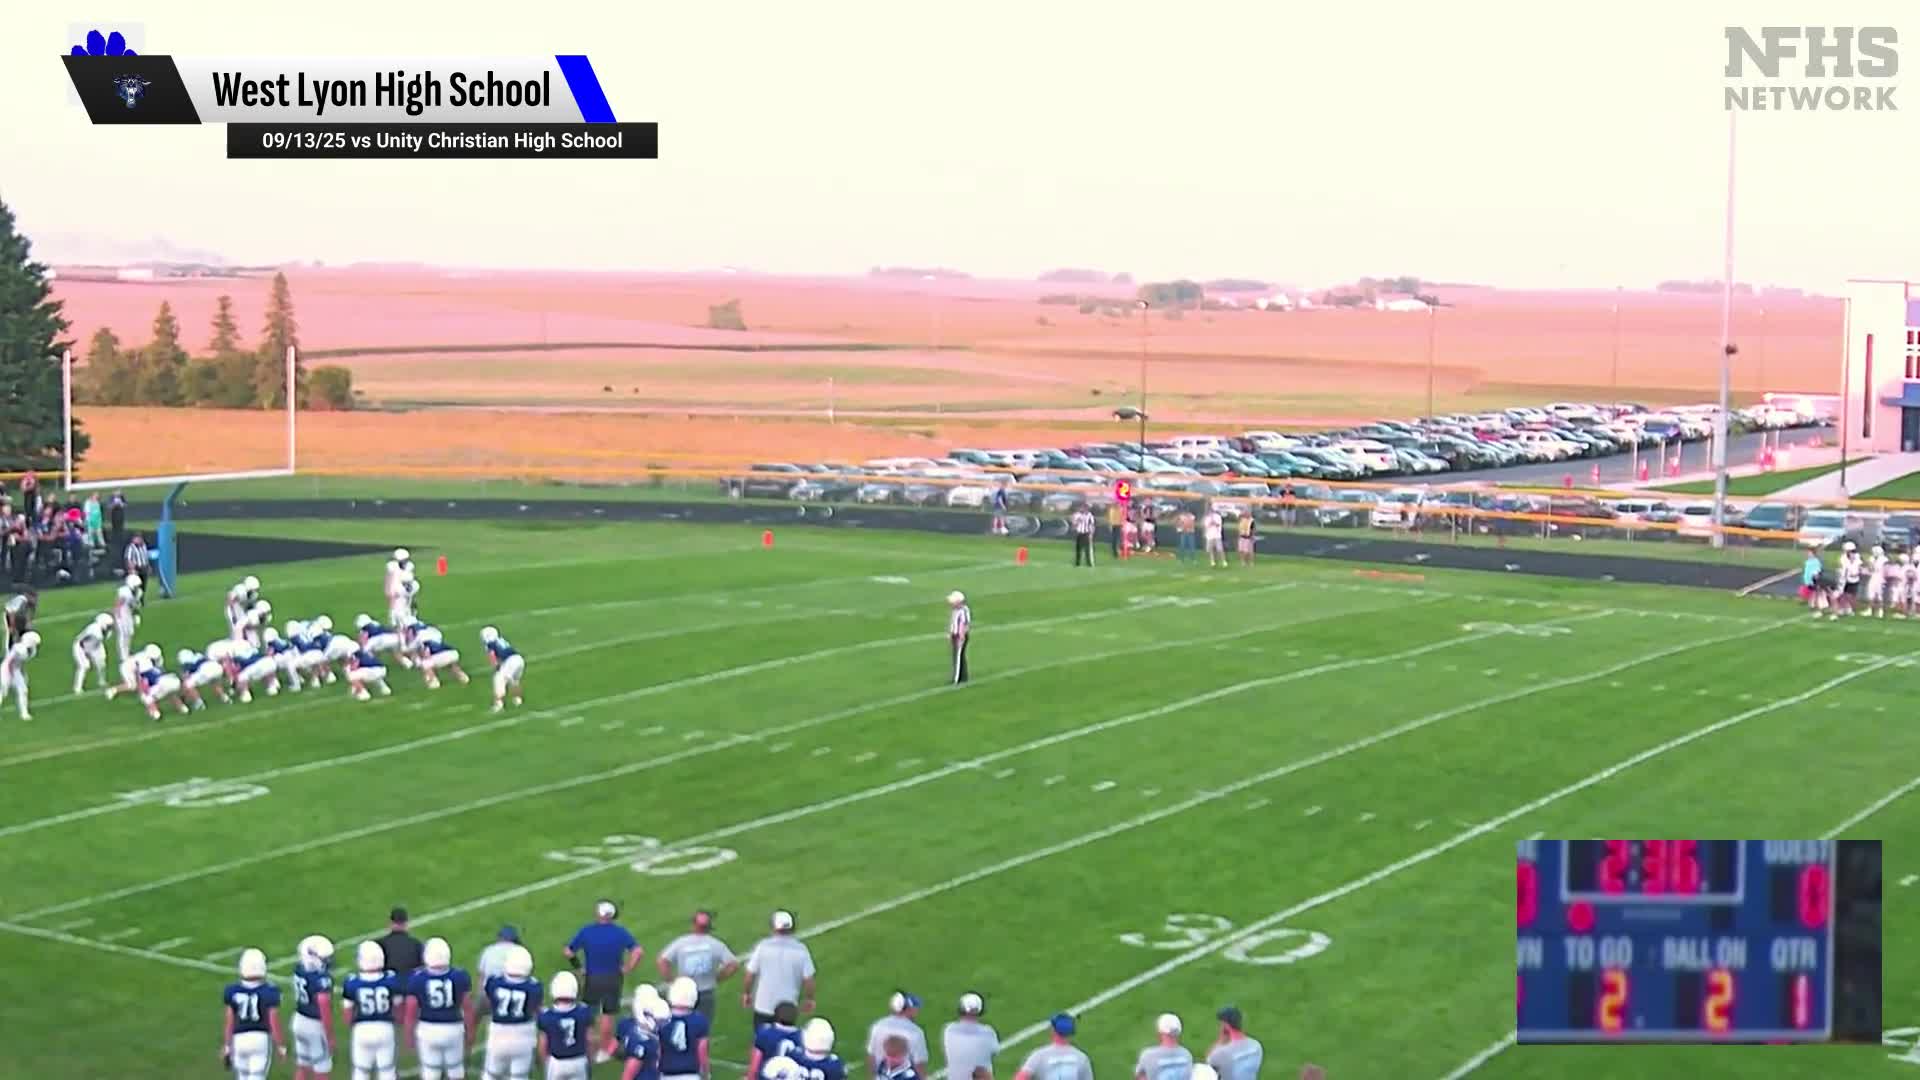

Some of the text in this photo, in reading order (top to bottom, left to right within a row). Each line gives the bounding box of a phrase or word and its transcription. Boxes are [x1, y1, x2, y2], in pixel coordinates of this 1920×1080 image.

[1564, 936, 1633, 969] TO GO
[1663, 936, 1747, 970] BALL ON
[1771, 937, 1817, 970] QTR
[232, 992, 260, 1021] 71
[357, 986, 390, 1015] 56
[426, 979, 455, 1008] 51
[496, 988, 526, 1017] 77
[1598, 968, 1628, 1033] 2
[1704, 968, 1734, 1032] 2
[559, 1018, 576, 1046] 7
[671, 1020, 687, 1051] 4
